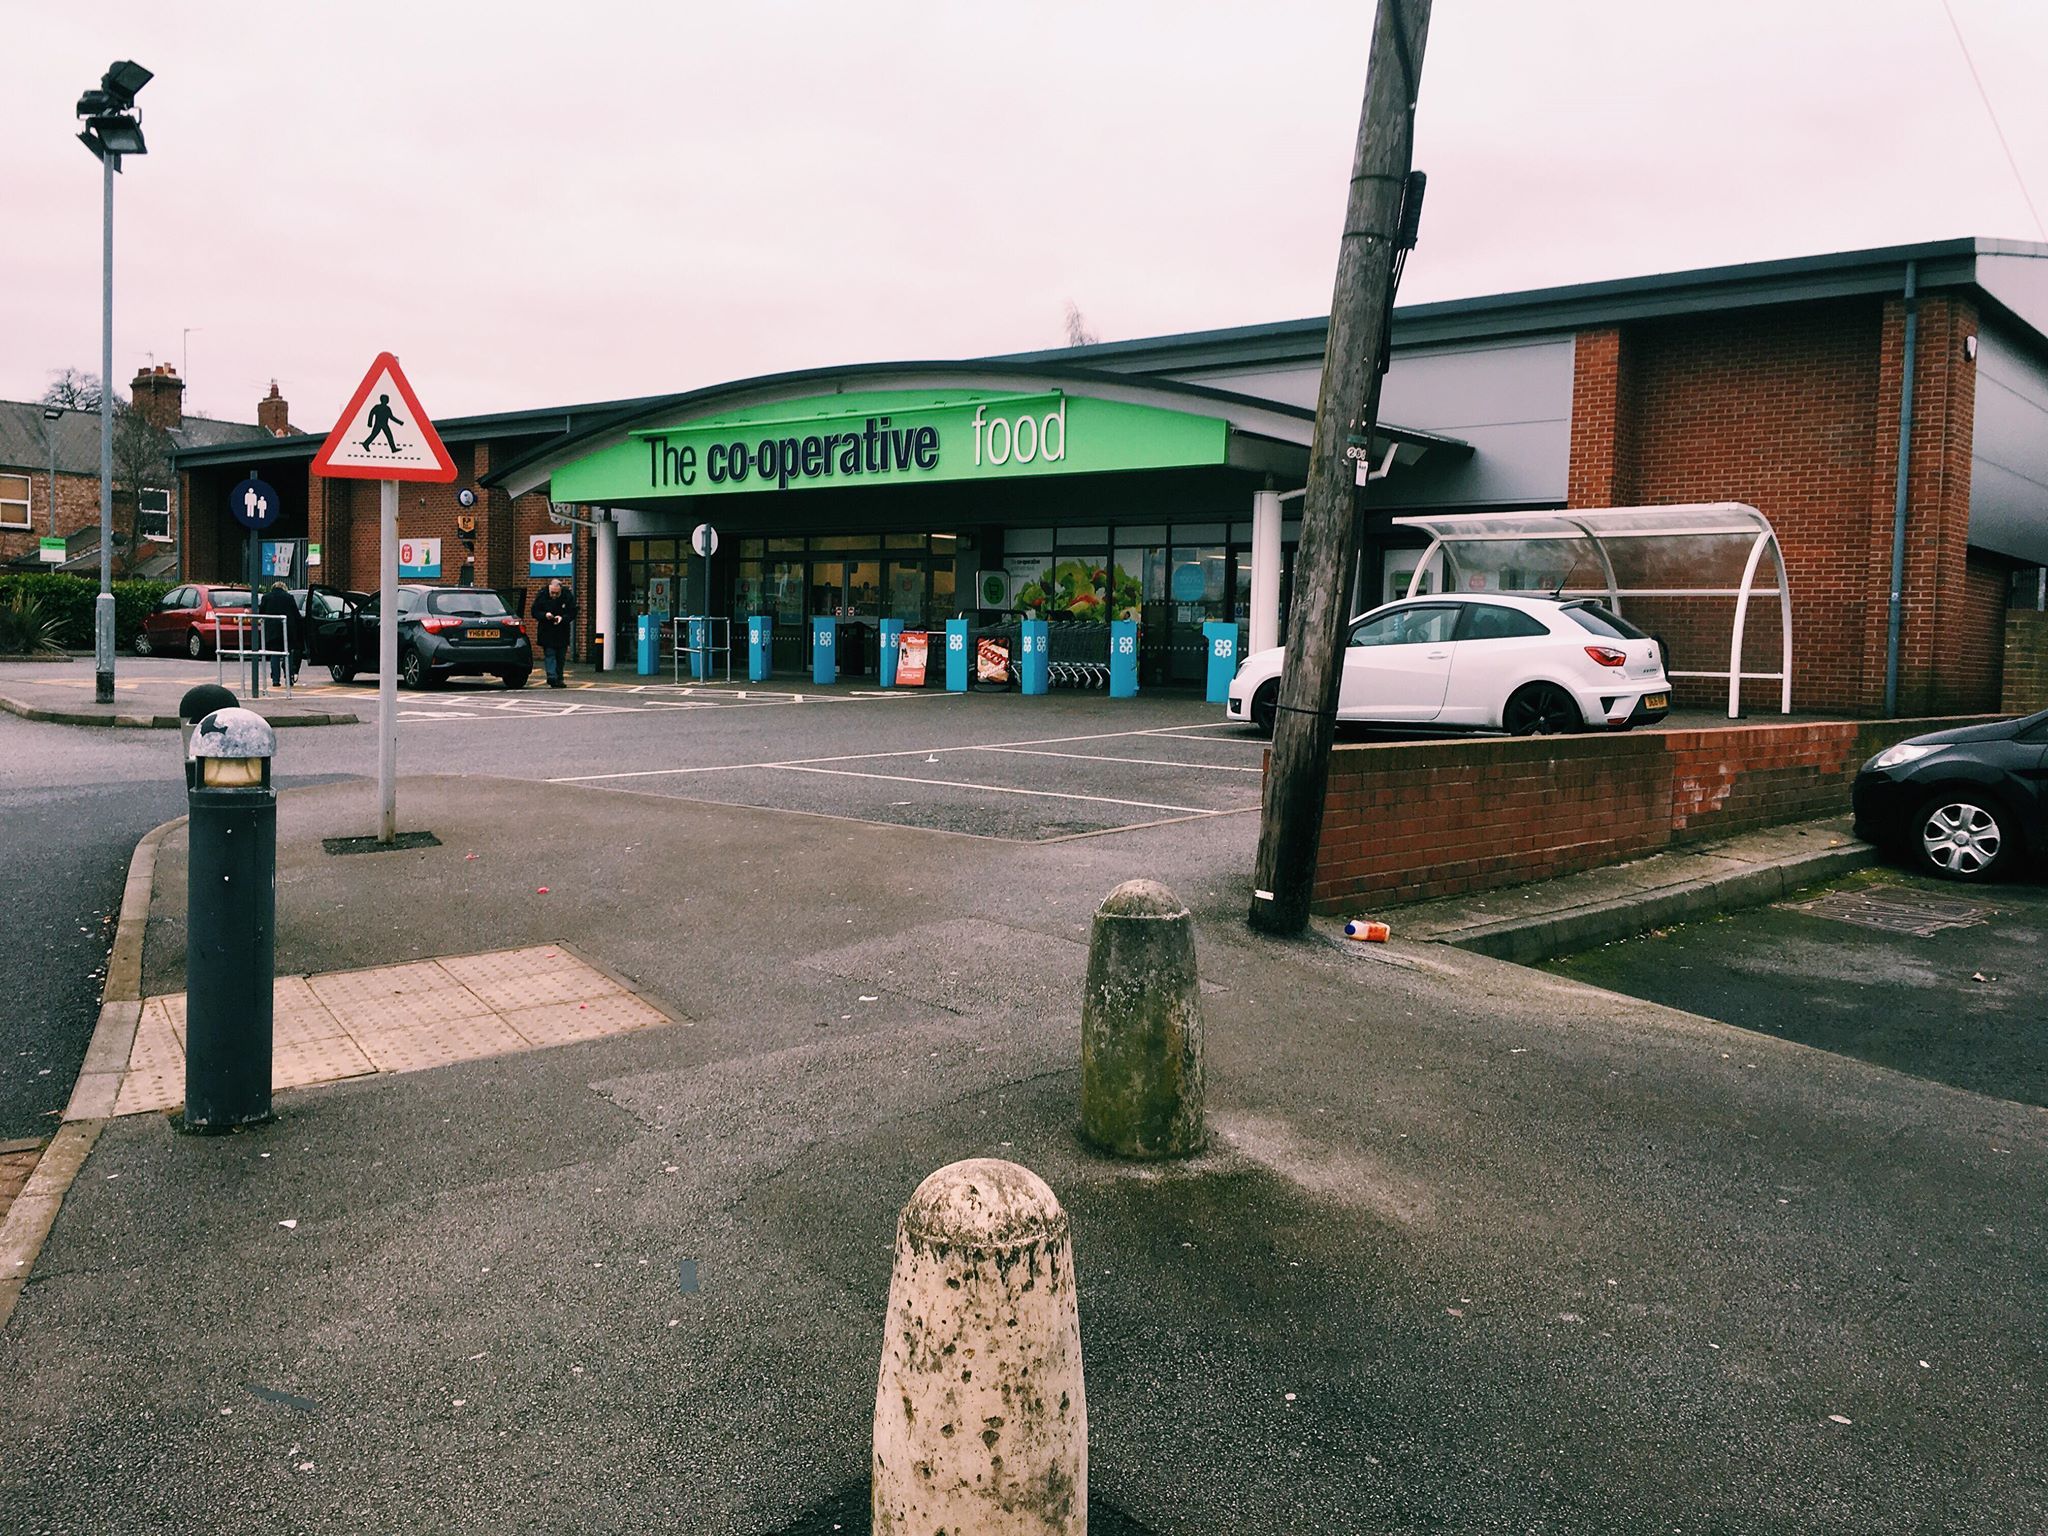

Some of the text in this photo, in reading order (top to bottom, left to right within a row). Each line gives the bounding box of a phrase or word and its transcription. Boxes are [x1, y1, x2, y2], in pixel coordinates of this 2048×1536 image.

[644, 398, 1067, 490] The co-operative food
